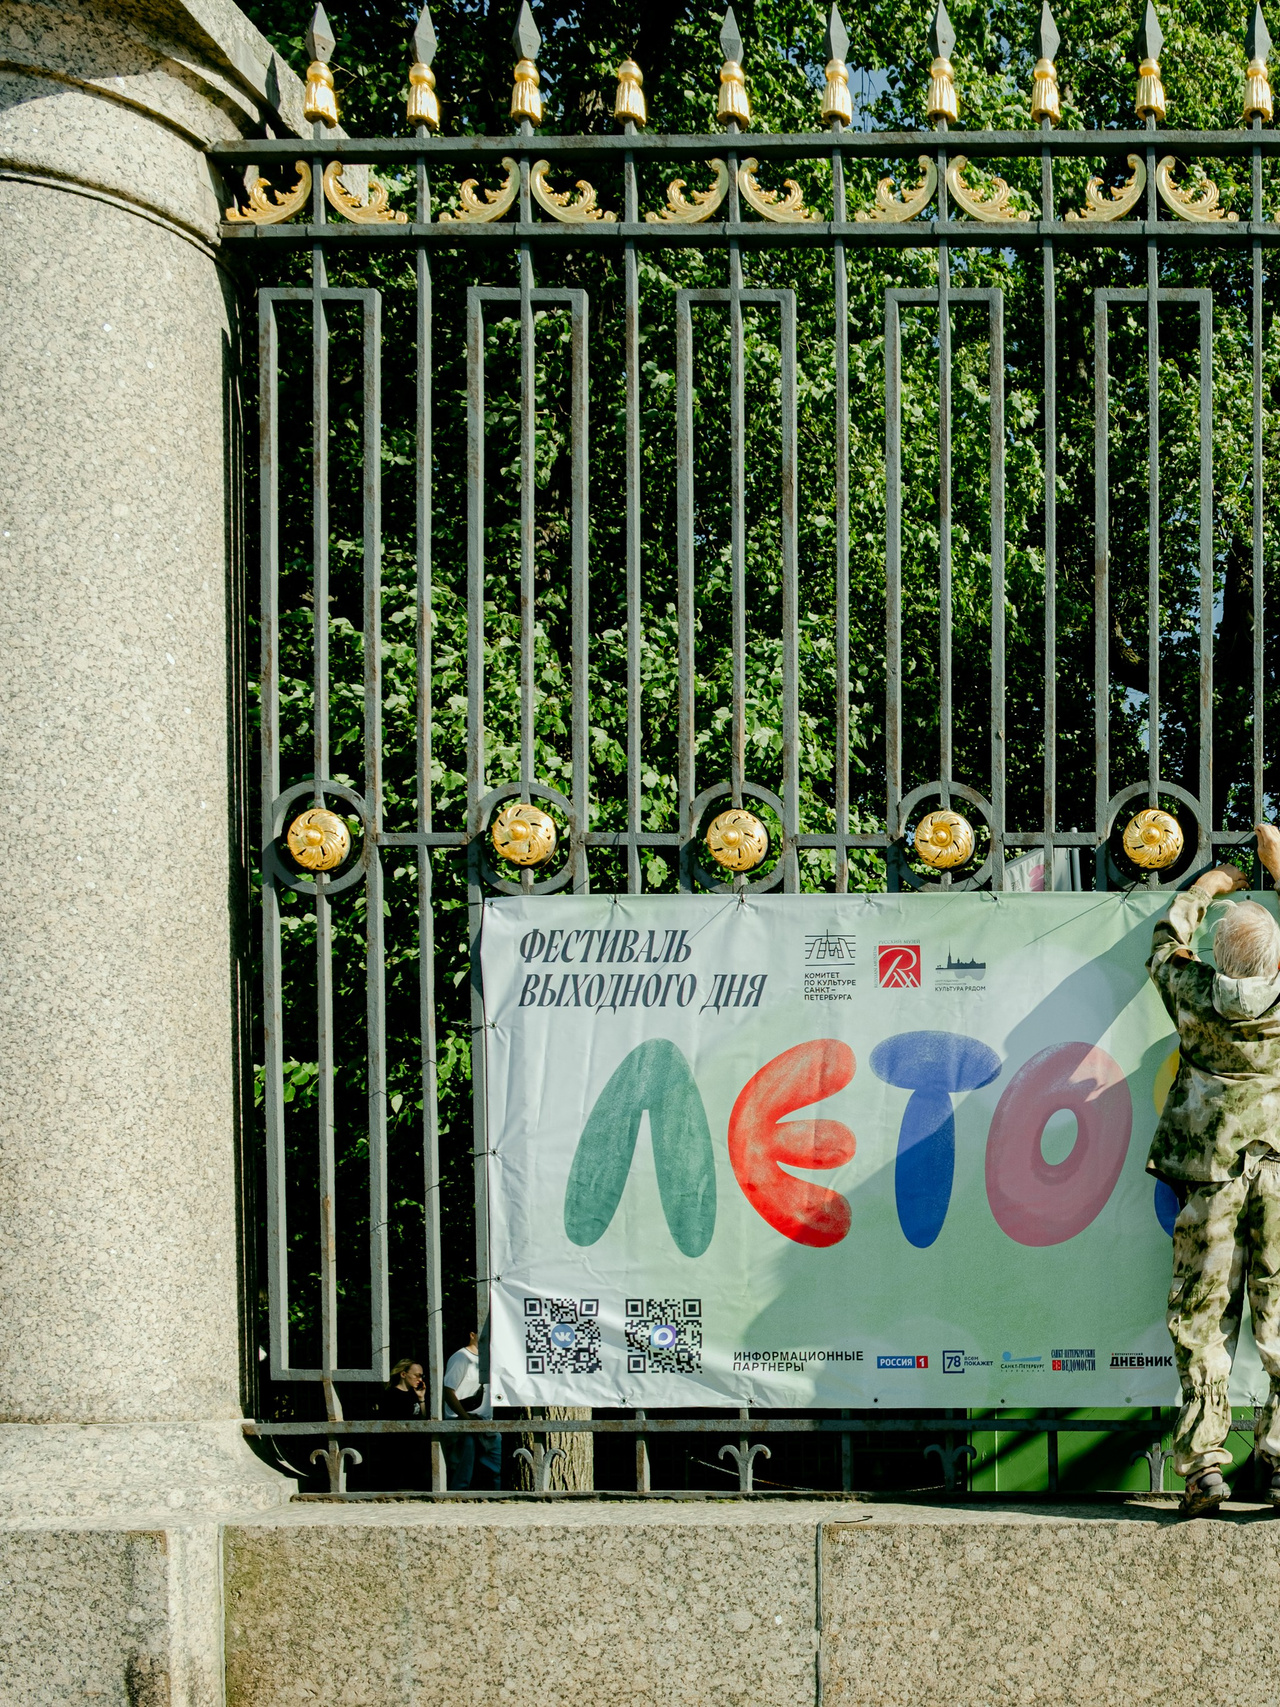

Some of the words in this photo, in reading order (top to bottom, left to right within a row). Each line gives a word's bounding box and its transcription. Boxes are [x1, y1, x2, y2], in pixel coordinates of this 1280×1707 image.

[519, 928, 692, 963] ФЕСТИВАЛЬ
[518, 973, 697, 1015] ВЫХОДНОГО
[698, 974, 768, 1015] ДНЯ
[564, 1030, 1133, 1258] ЛЕТО
[734, 1350, 864, 1363] ИНФОРМАЦИОННЫЕ
[880, 1358, 913, 1366] РОССИЯ
[919, 1357, 925, 1367] 1
[946, 1355, 961, 1369] 78
[1110, 1356, 1173, 1367] ДНЕВНИК
[732, 1362, 804, 1371] ПАРТНЕРЫ
[1062, 1359, 1096, 1372] ВЕДОМОСТИ
